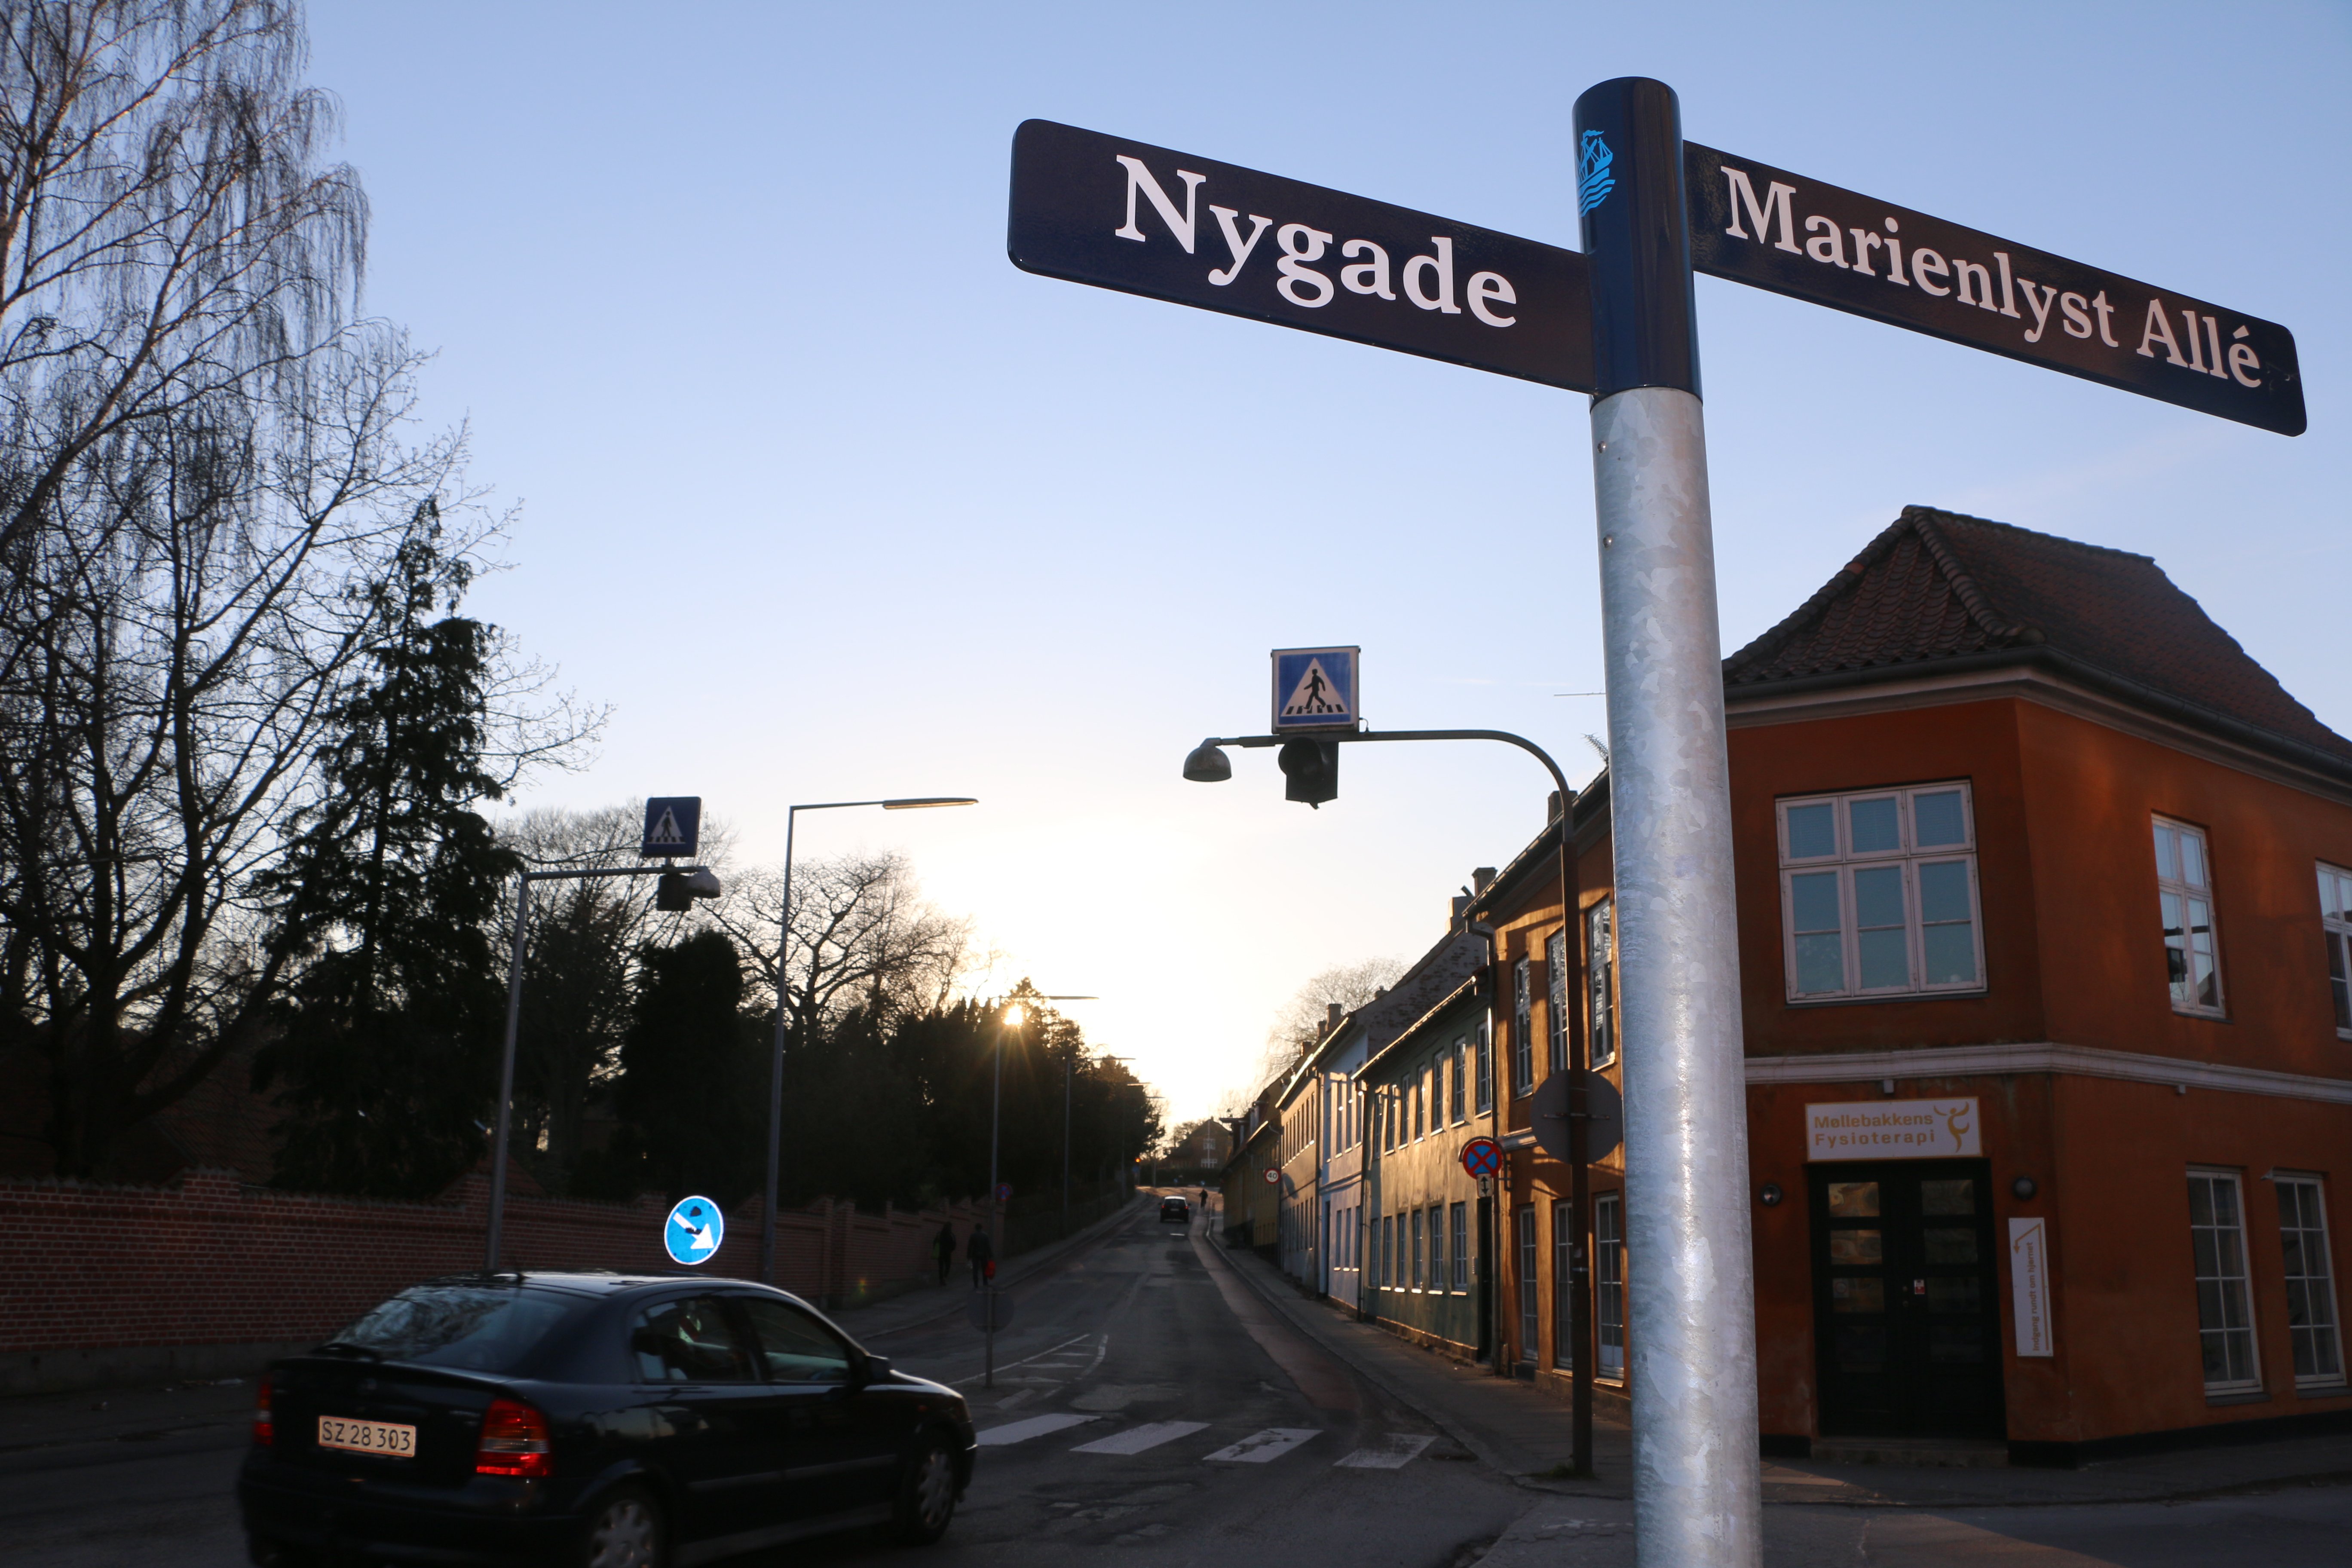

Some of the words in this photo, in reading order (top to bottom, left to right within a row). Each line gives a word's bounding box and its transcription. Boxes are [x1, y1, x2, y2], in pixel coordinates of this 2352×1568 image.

[1115, 154, 1516, 328] Nygade
[1721, 166, 2119, 347] Marienlyst
[2136, 298, 2262, 388] Allé
[1814, 1113, 1934, 1129] Møllebakkens
[1815, 1130, 1934, 1149] Fysioterapi
[2029, 1275, 2036, 1288] om
[2029, 1291, 2037, 1314] rundt
[2032, 1316, 2040, 1351] Indgang
[322, 1421, 345, 1442] SZ
[350, 1425, 371, 1446] 28
[377, 1428, 410, 1451] 303
